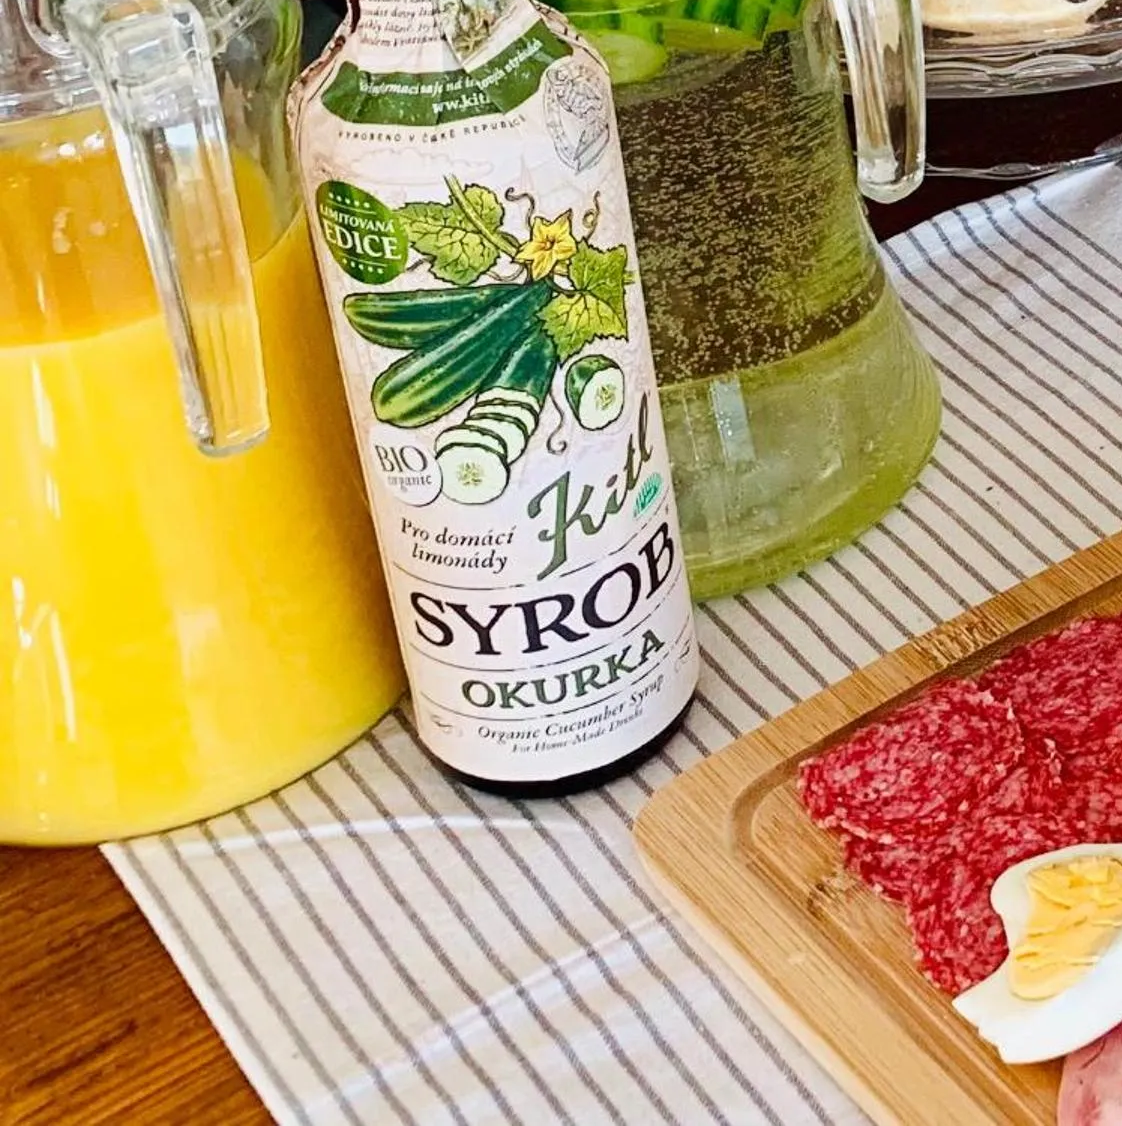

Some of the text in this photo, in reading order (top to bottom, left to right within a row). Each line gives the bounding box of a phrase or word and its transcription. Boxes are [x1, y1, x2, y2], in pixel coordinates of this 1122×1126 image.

[322, 218, 401, 260] EDICE
[375, 445, 428, 473] BIO
[527, 391, 653, 581] Kitl
[401, 517, 517, 547] Pro domácí
[411, 543, 508, 574] limonády
[410, 521, 676, 656] SYROB
[462, 628, 666, 710] OKURKA
[477, 674, 664, 745] Organic Cucumber Syrup
